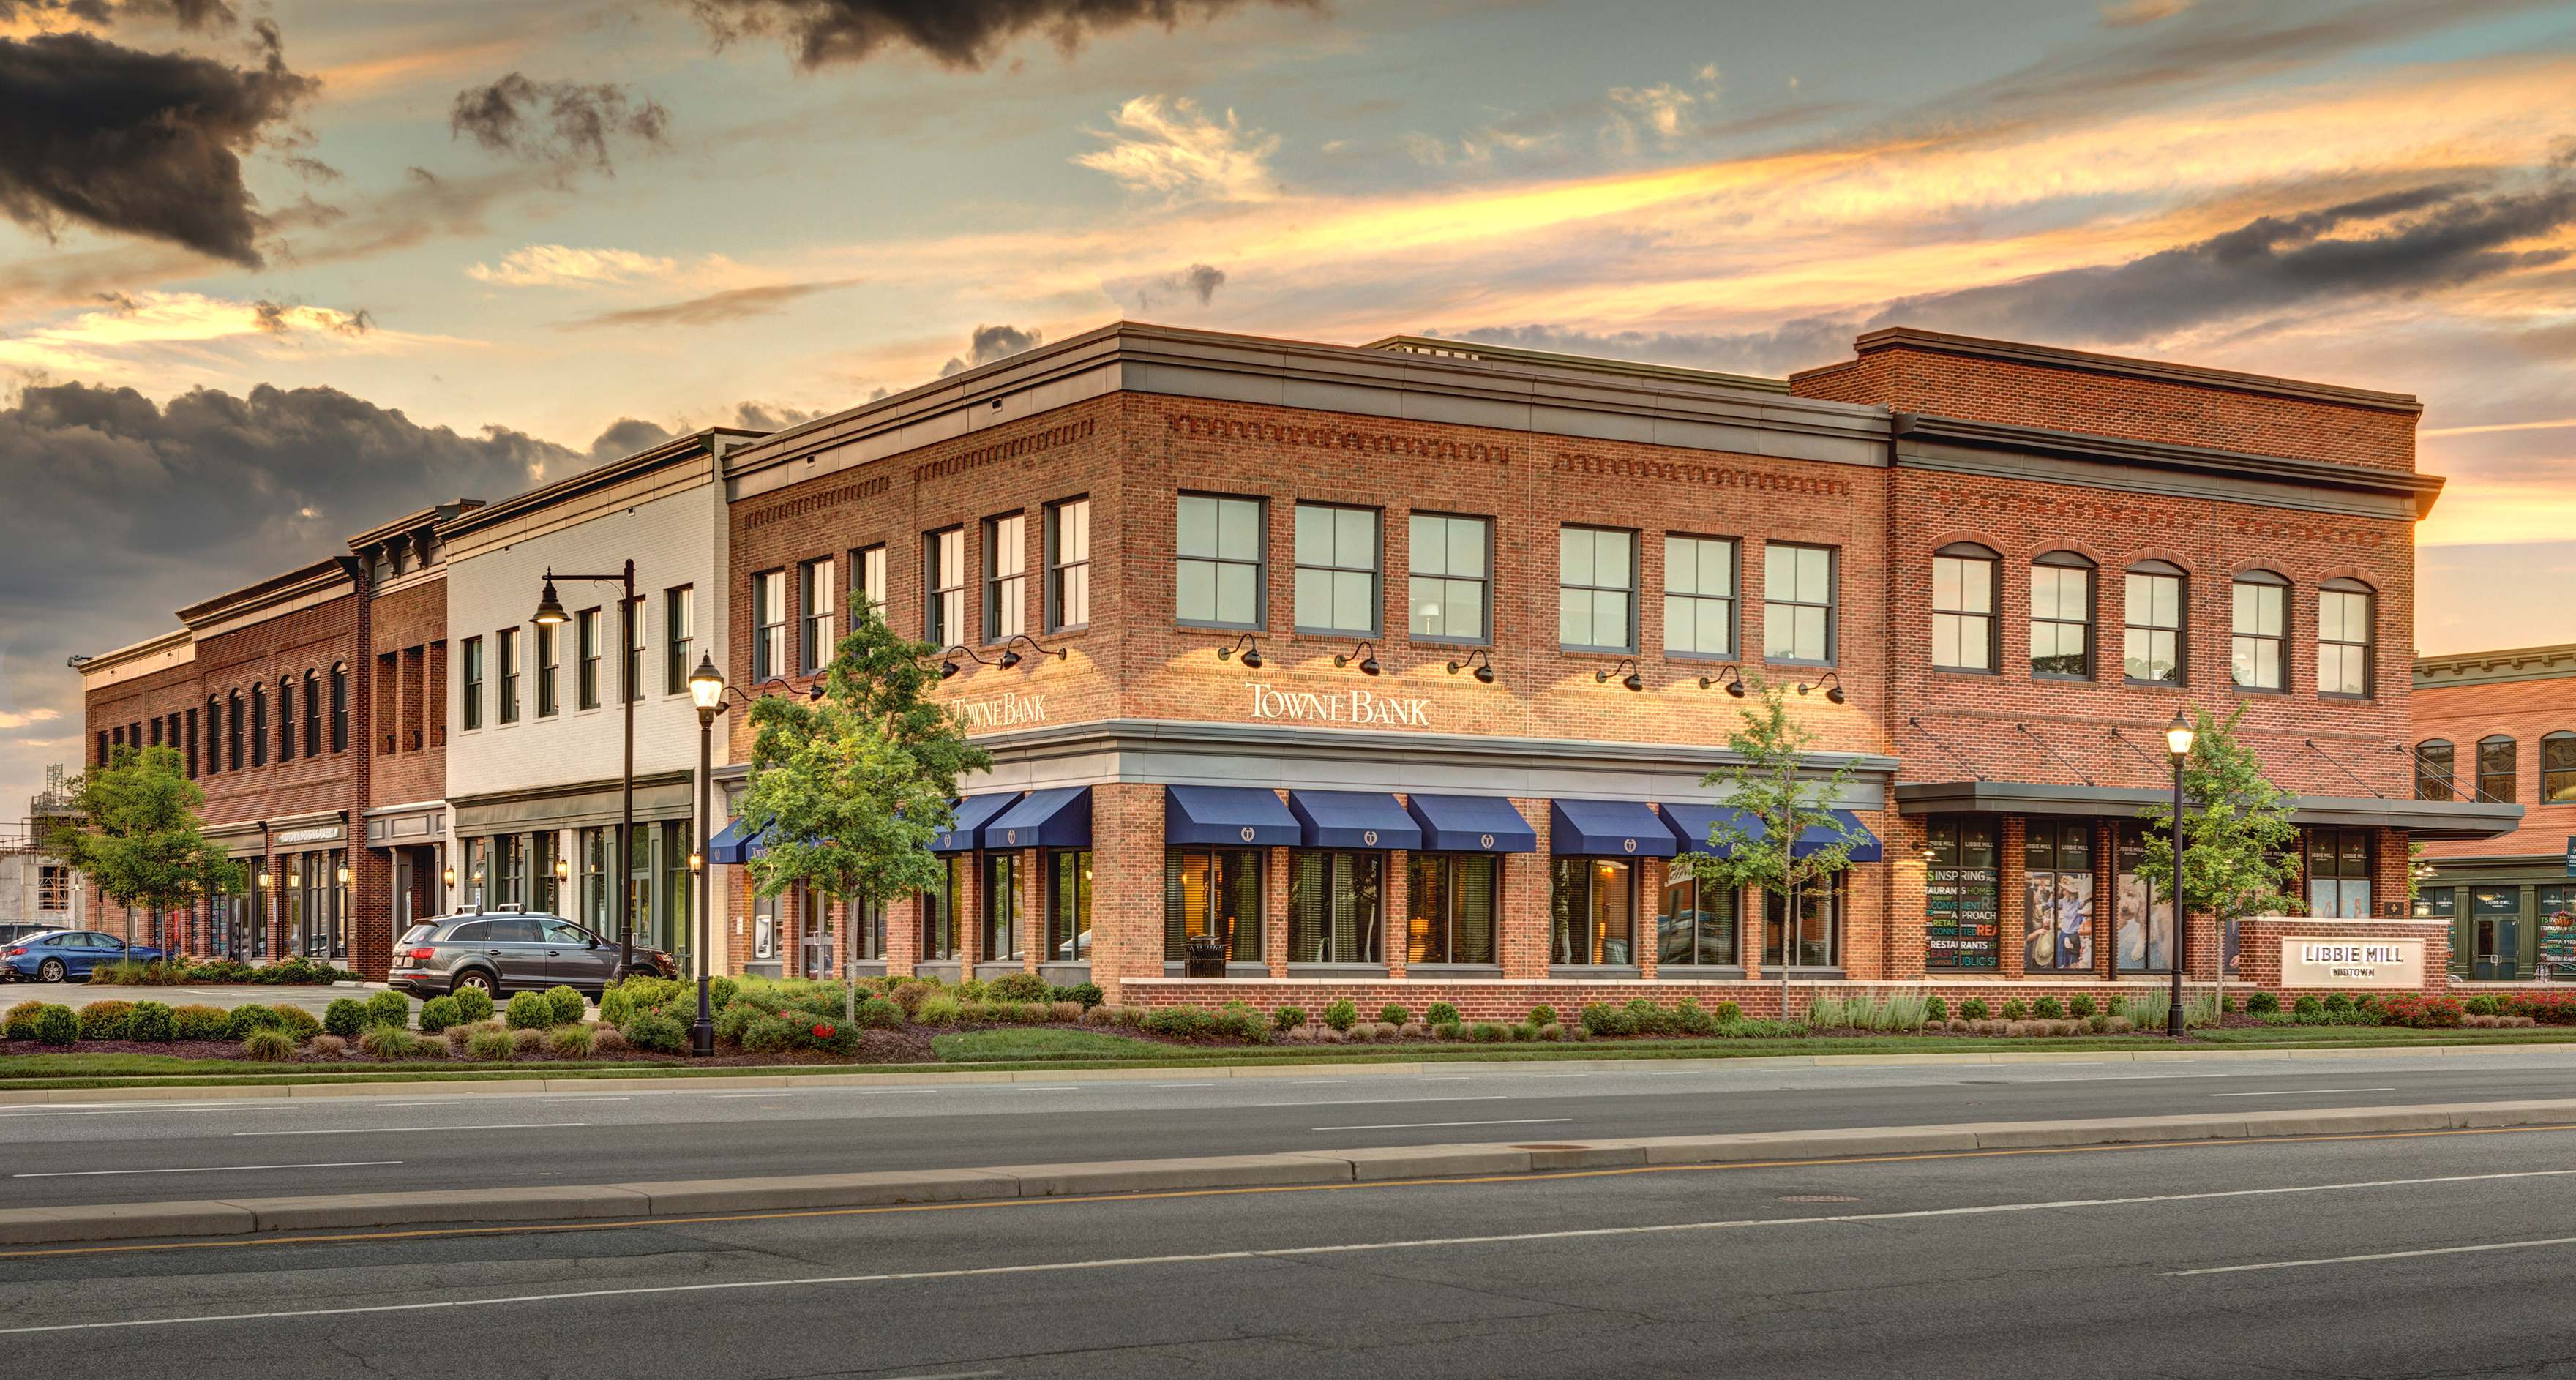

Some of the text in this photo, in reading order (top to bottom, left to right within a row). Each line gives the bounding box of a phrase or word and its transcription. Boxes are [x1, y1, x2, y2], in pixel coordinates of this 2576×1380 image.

[1935, 871, 1985, 881] INSPRING
[1967, 887, 1996, 895] HOMES
[1951, 911, 1996, 920] APROACH
[1933, 928, 1977, 936] CONNETED
[1931, 950, 1954, 958] EASY
[2305, 946, 2404, 963] LIBBIE MILL
[2332, 968, 2375, 976] MIDTOWN
